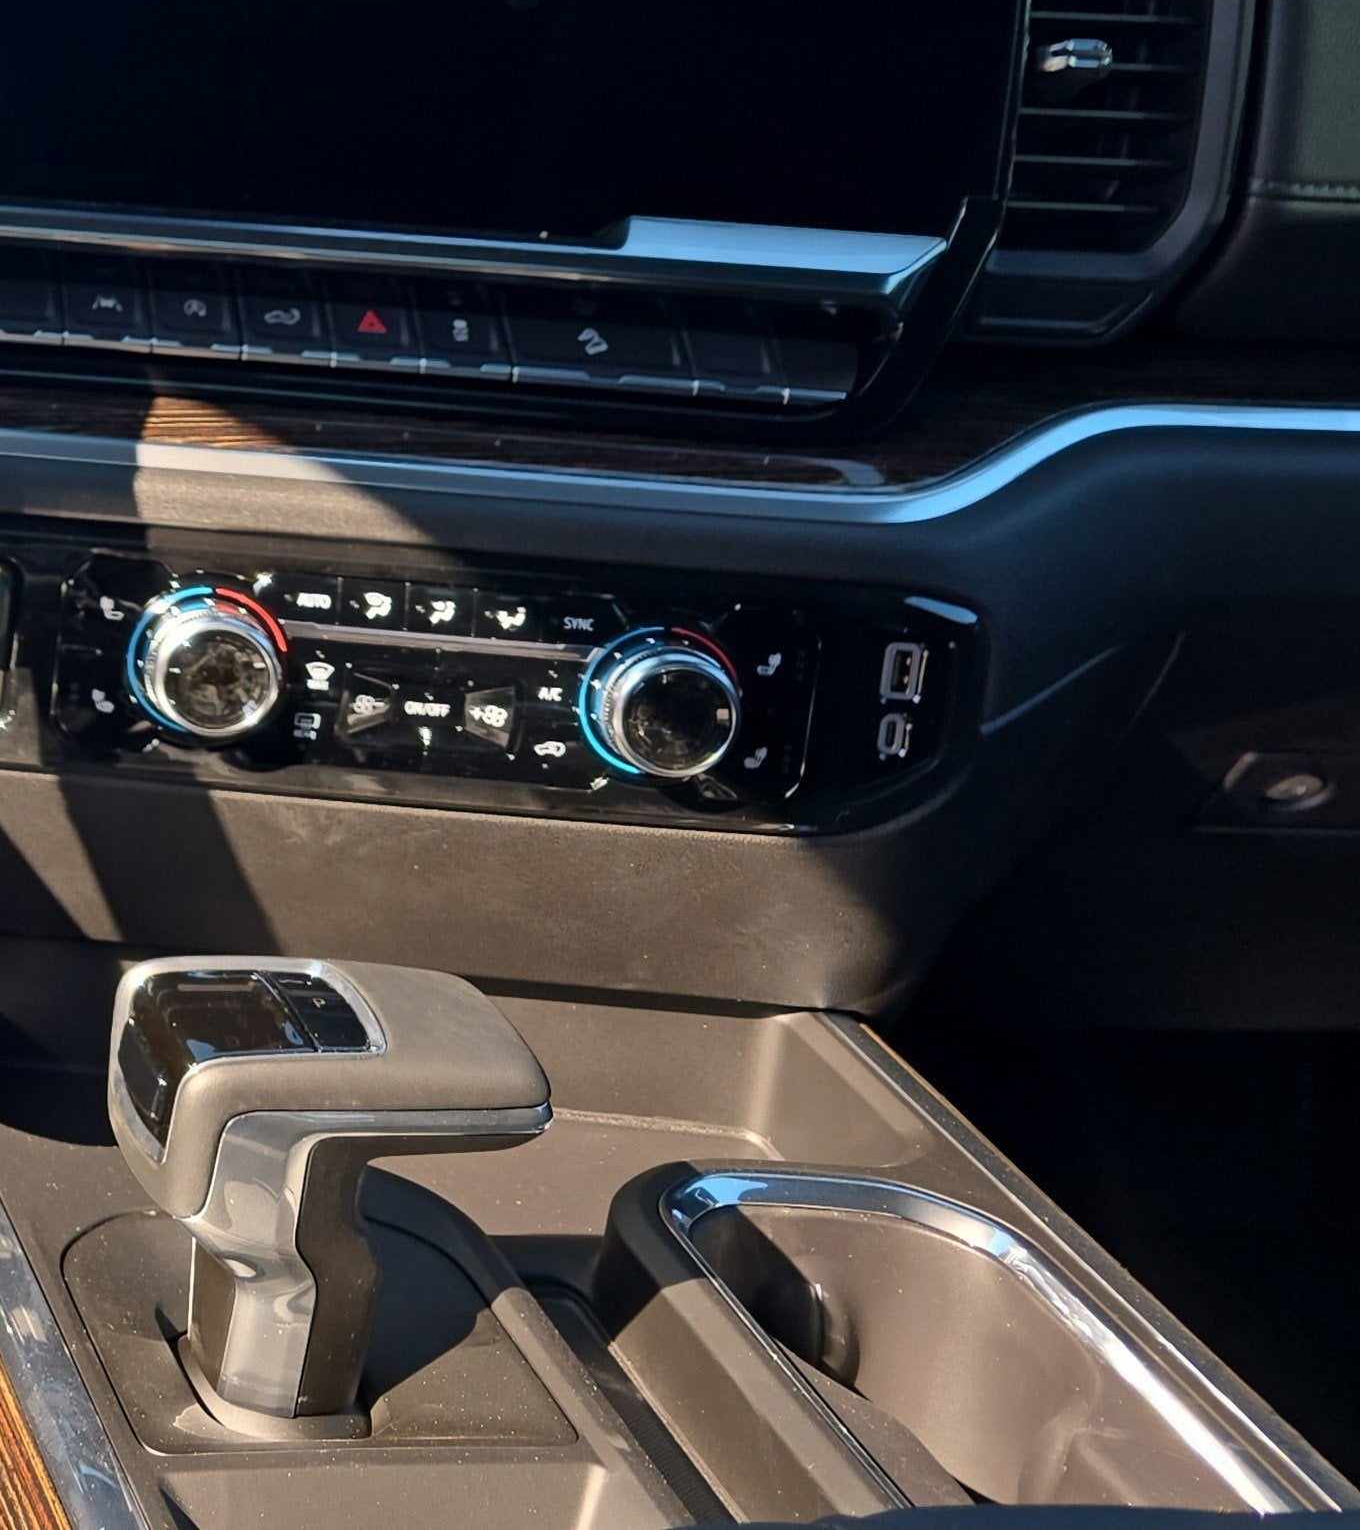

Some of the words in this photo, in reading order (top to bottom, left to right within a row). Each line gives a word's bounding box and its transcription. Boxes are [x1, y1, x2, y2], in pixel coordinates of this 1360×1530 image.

[563, 616, 595, 632] SYNC
[404, 700, 451, 718] ON/OFF
[312, 997, 326, 1009] P
